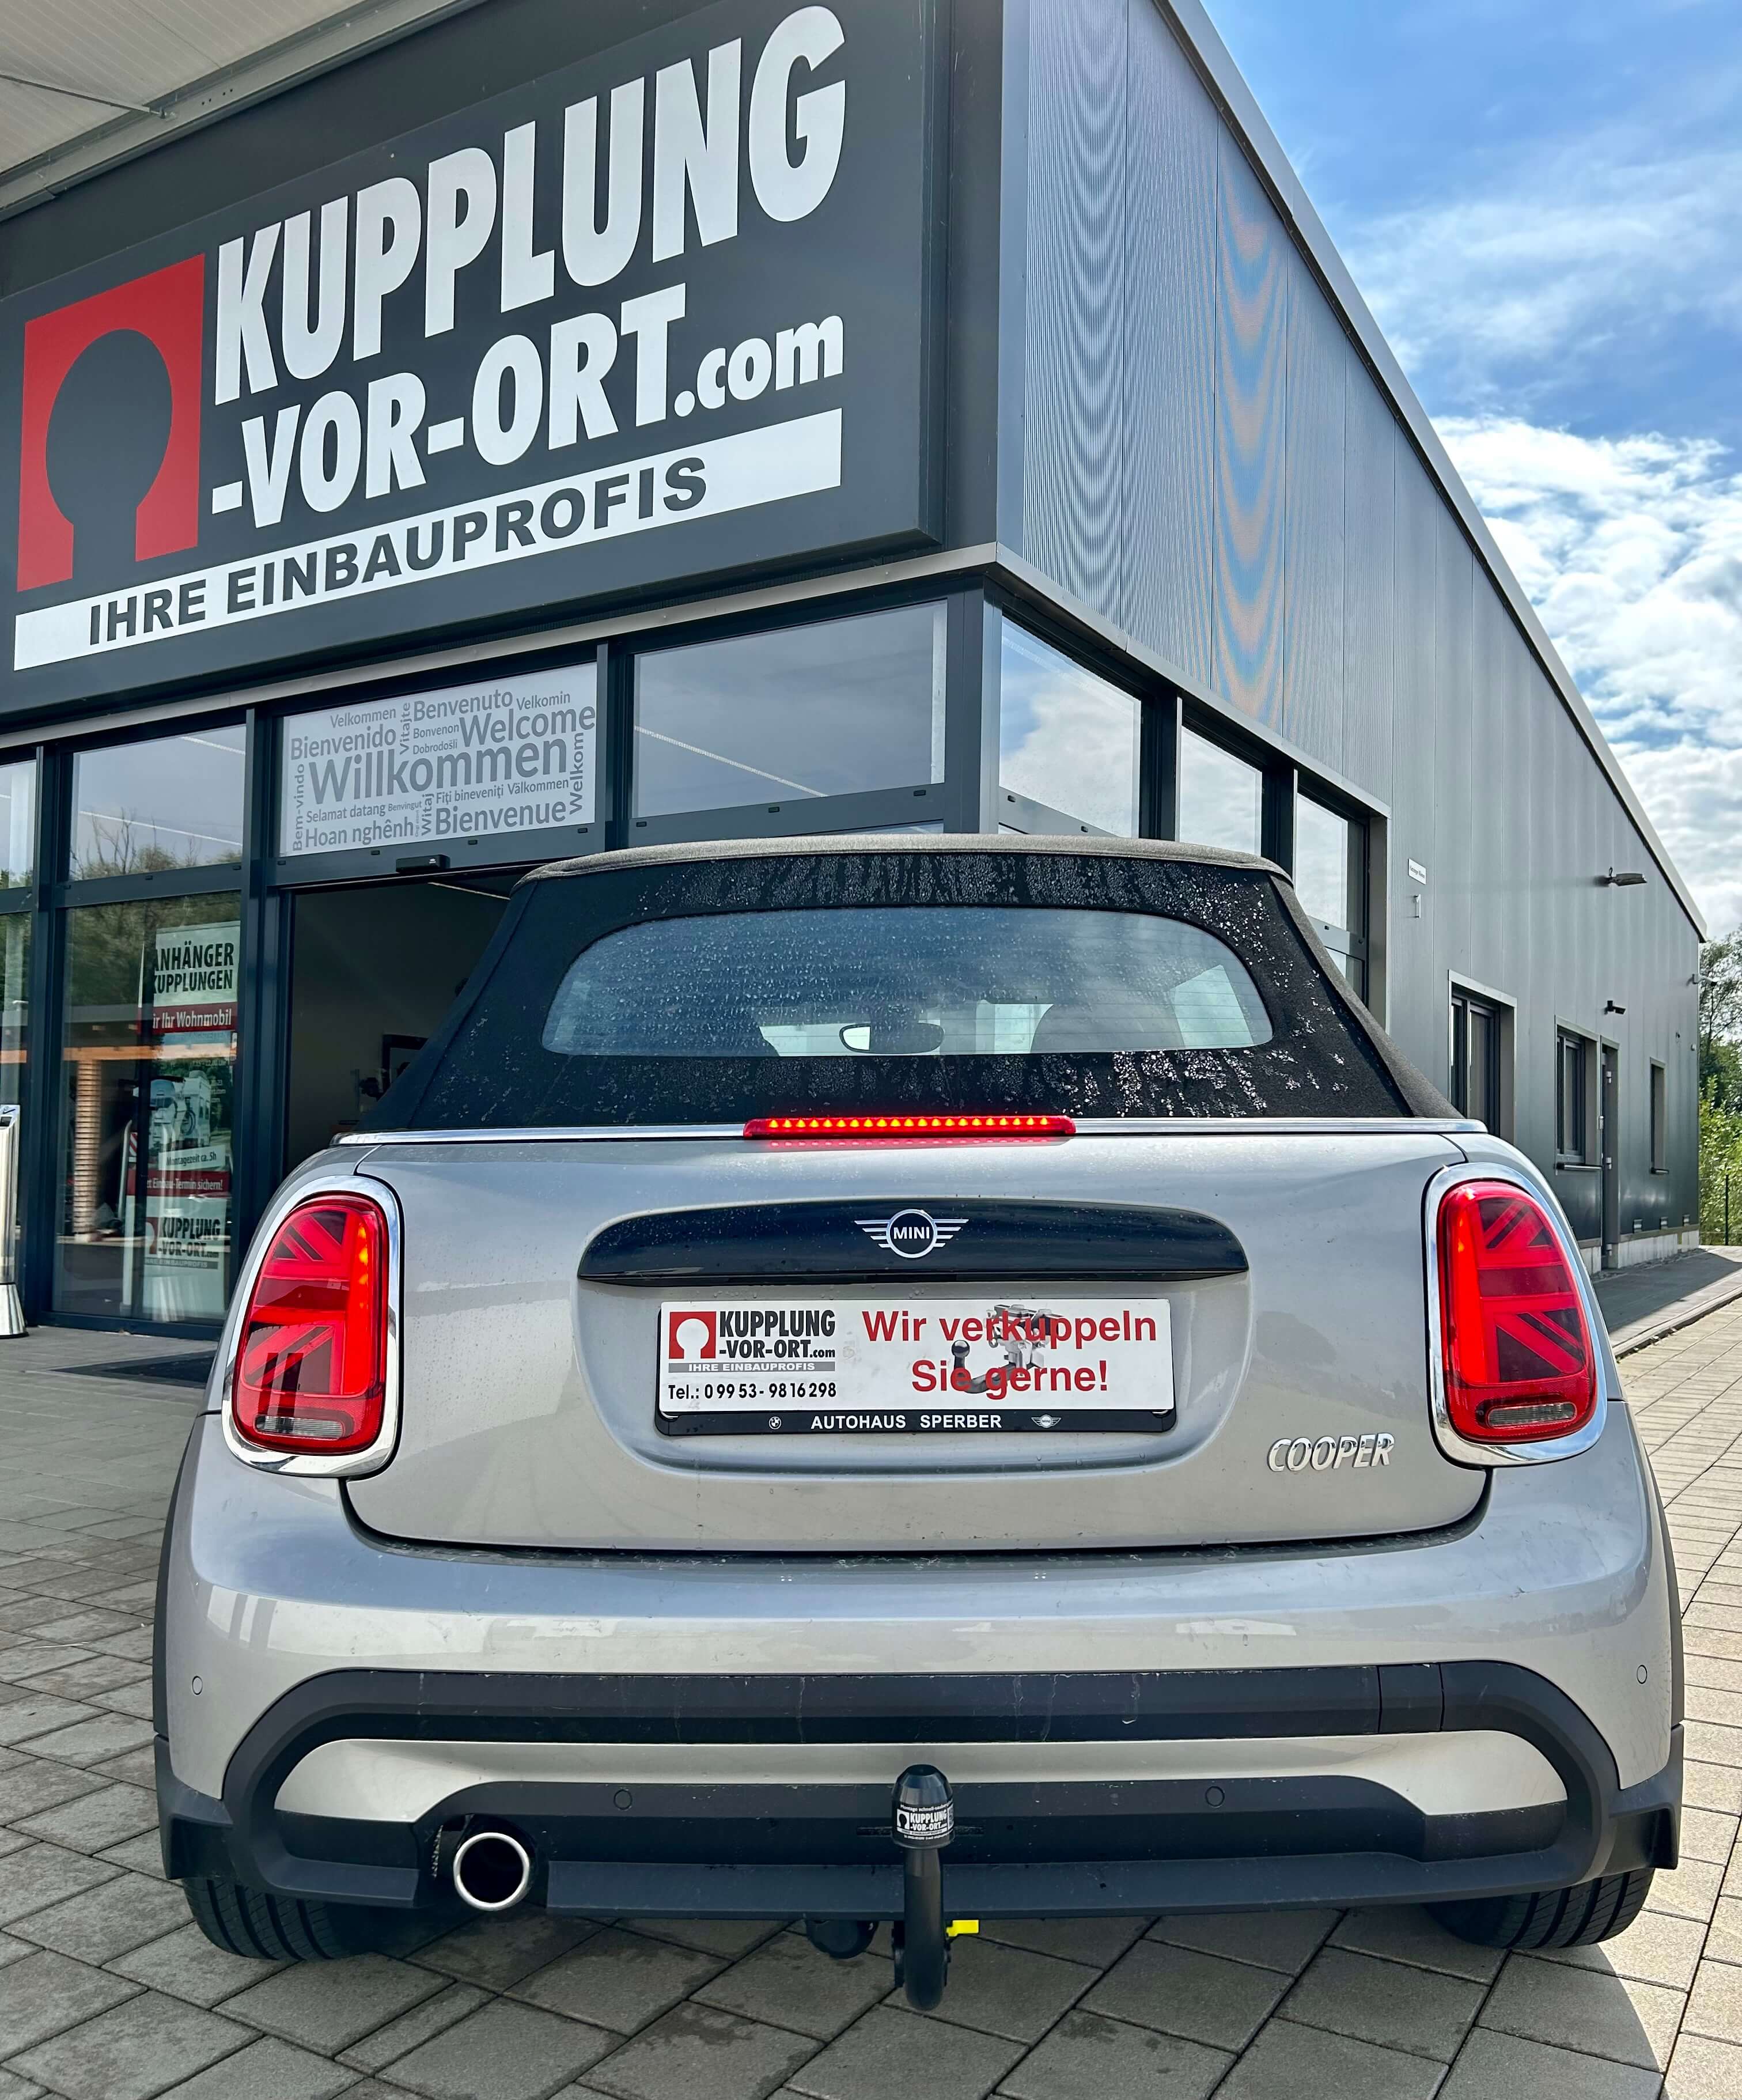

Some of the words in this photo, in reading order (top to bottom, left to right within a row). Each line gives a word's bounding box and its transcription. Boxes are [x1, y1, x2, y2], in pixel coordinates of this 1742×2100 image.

[215, 5, 846, 405] KUPPLUNG
[212, 282, 844, 528] -VOR-ORT.com
[89, 580, 206, 645] IHRE
[227, 457, 706, 615] EINBAUPROFIS
[414, 689, 513, 721] Benvenuto
[517, 691, 570, 710] Velkomin
[331, 708, 396, 728] Velkommen
[400, 702, 412, 755] Vitajte
[413, 724, 459, 739] Bonvenon
[459, 705, 596, 747] Welcome
[291, 724, 396, 760] Bienvenido
[413, 739, 457, 755] Dobrodošli
[309, 738, 566, 804] Willkommen
[569, 732, 584, 815] Welkom
[508, 780, 569, 795] Välkommen
[293, 763, 305, 852] Bem-vindo
[306, 807, 347, 823] Selamat
[350, 804, 385, 818] datang
[421, 793, 434, 836] Witaj
[436, 801, 566, 835] Bienvenue
[305, 827, 347, 847] Hoan
[353, 816, 413, 845] nghênh
[162, 1012, 175, 1028] Ihr
[176, 1008, 232, 1028] Wohnmobil
[893, 1227, 930, 1239] MINI
[719, 1310, 835, 1337] KUPPLUNG
[862, 1311, 926, 1341] Wir
[939, 1310, 1157, 1349] verkuppeln
[719, 1340, 835, 1359] -VOR-ORT.com
[688, 1363, 718, 1372] IHRE
[722, 1362, 815, 1372] EINBAUPROFIS
[911, 1360, 972, 1392] Sie
[986, 1360, 1108, 1400] gerne!
[668, 1384, 699, 1399] Tel.:
[811, 1415, 906, 1429] AUTOHAUS
[920, 1414, 1002, 1428] SPERBER
[1267, 1433, 1395, 1471] COOPER
[910, 1809, 947, 1824] KUPPLUNG
